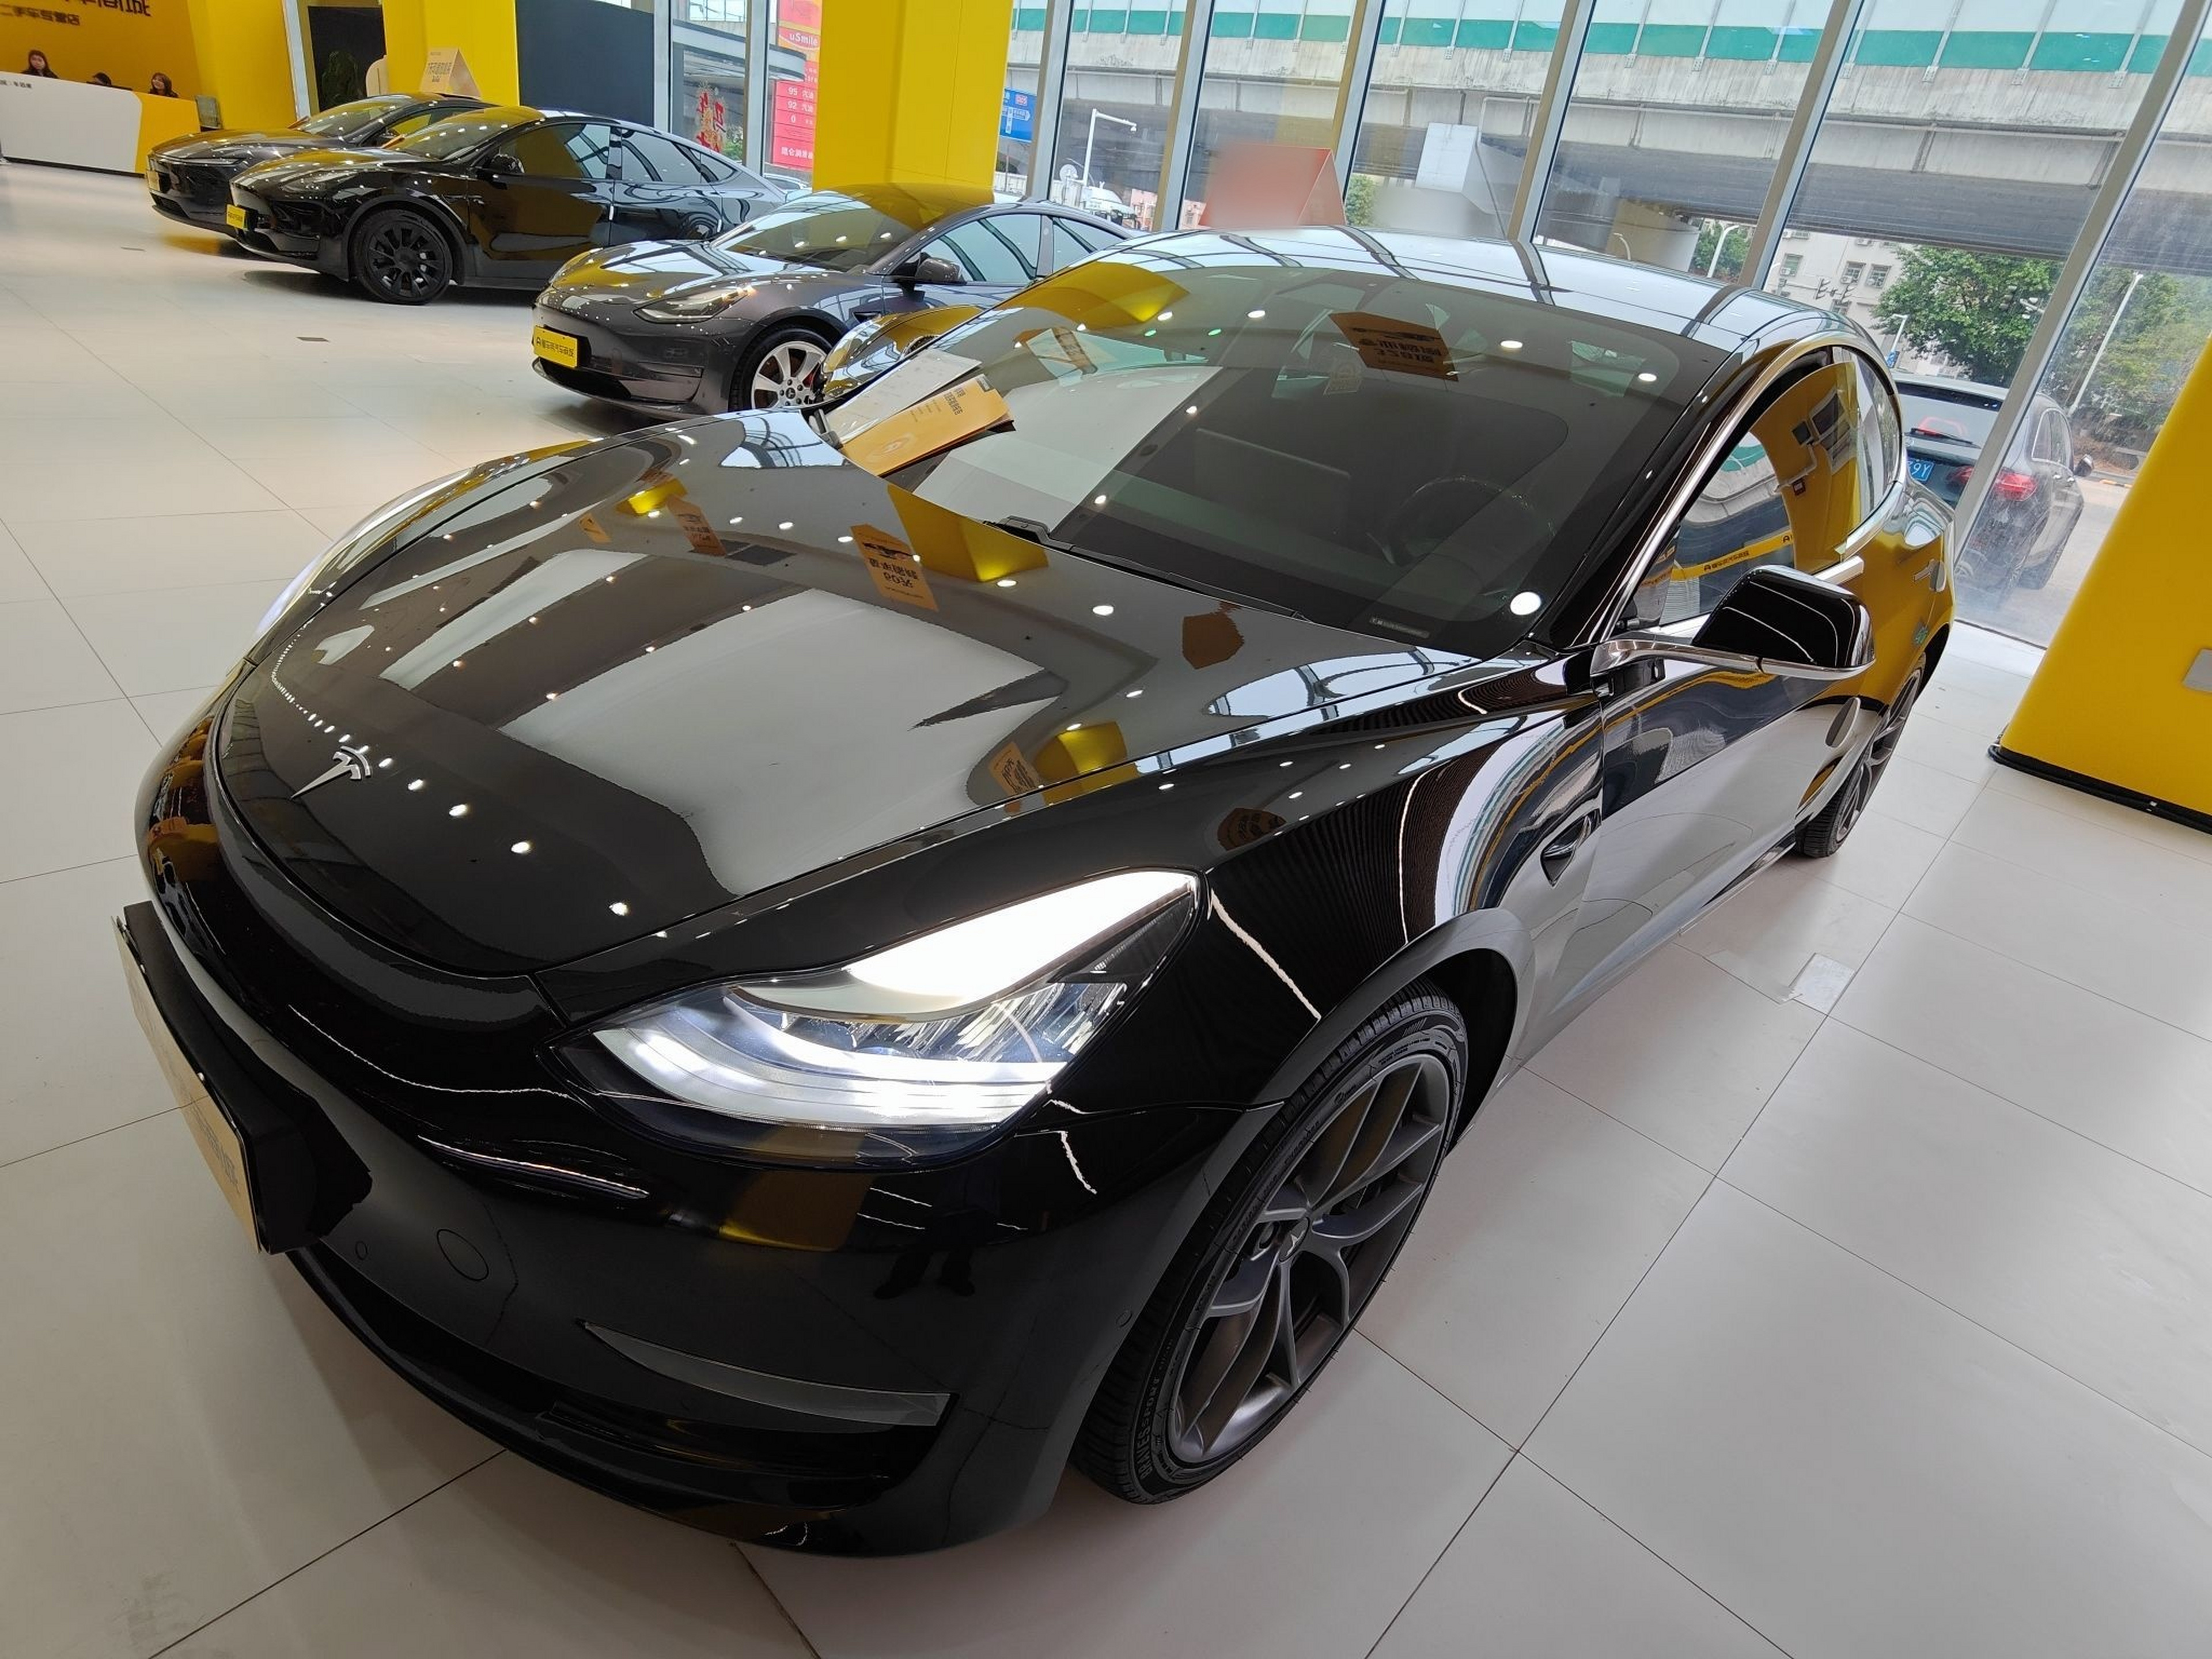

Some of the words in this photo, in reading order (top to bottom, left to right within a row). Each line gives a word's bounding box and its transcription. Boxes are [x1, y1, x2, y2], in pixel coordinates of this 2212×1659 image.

[790, 33, 818, 45] uSmile
[787, 87, 798, 96] 95
[787, 100, 797, 109] 92
